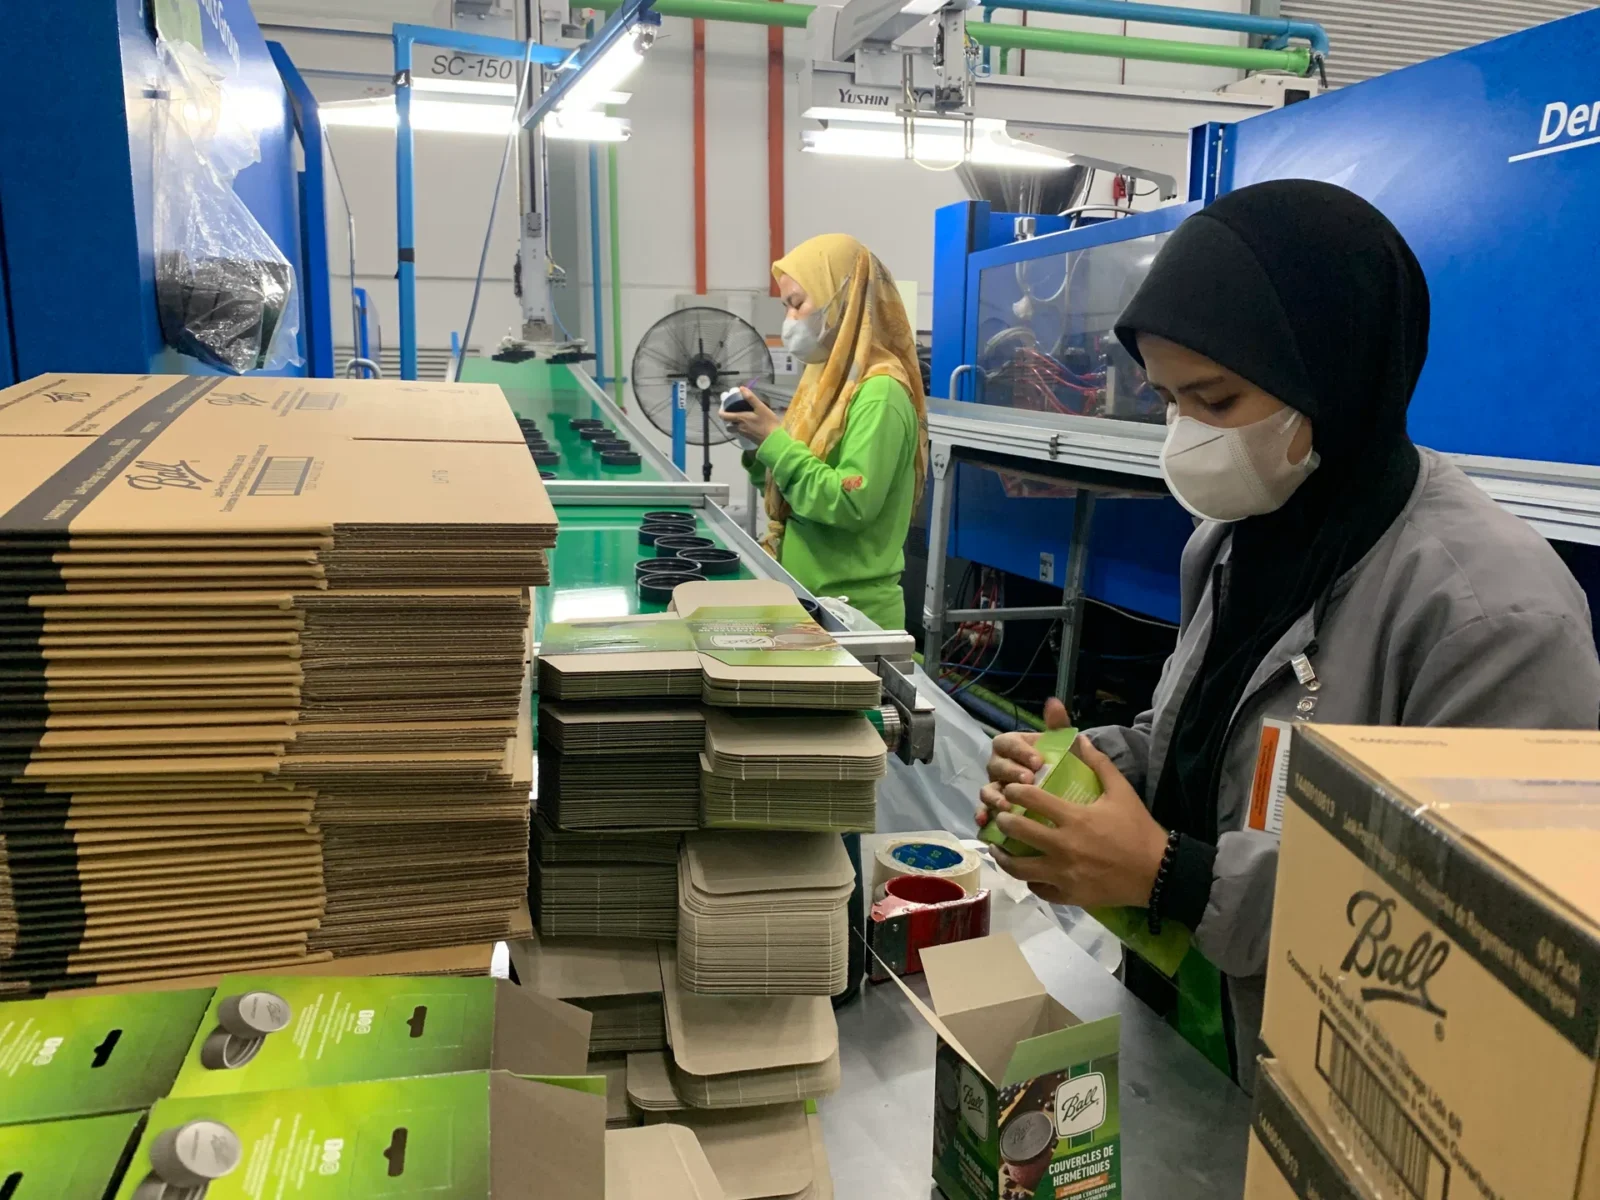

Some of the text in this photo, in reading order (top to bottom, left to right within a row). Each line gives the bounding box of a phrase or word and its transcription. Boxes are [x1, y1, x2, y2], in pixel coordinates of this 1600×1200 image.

[431, 54, 513, 80] SC-150
[838, 88, 889, 106] YUSHIN
[124, 459, 214, 491] Ball
[1340, 890, 1449, 1018] Ball
[963, 1084, 984, 1113] Ball
[1062, 1085, 1099, 1123] Ball
[1048, 1144, 1114, 1175] COUVERCLES DE
[1053, 1159, 1111, 1187] HERMÉTIQUES
